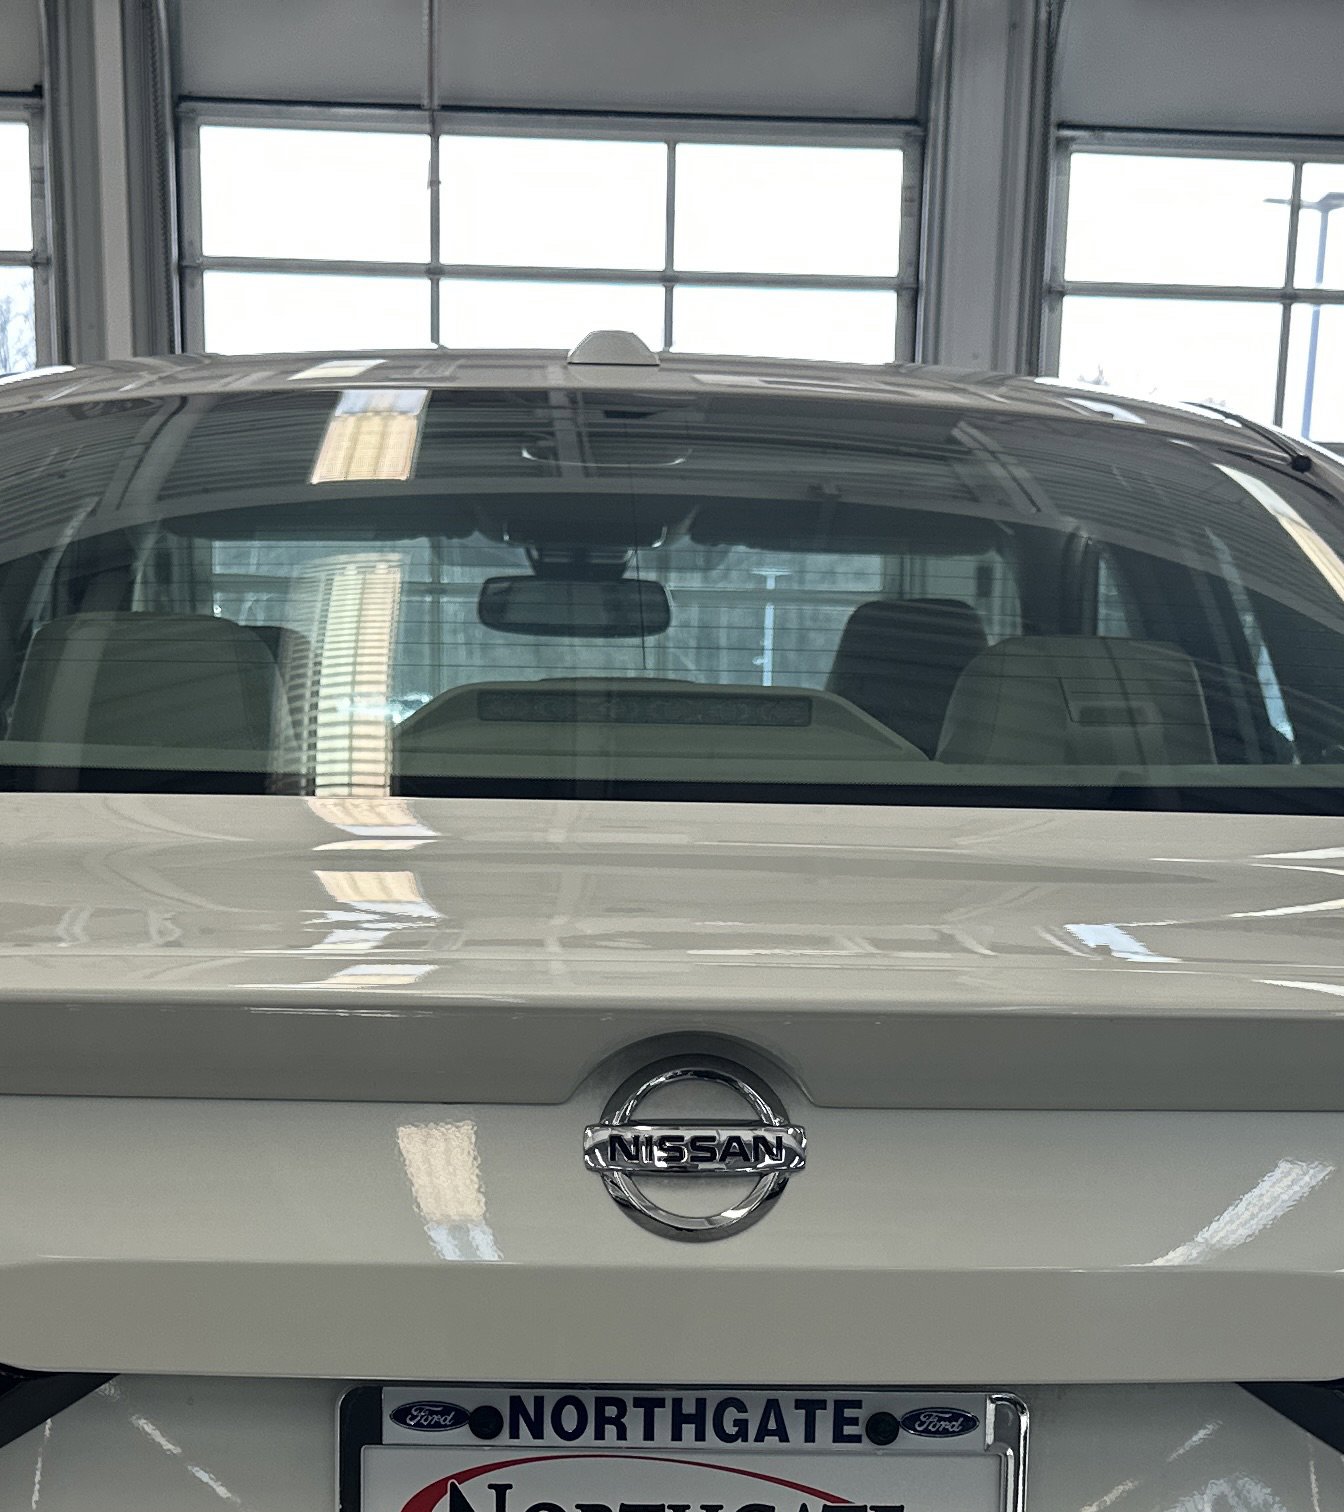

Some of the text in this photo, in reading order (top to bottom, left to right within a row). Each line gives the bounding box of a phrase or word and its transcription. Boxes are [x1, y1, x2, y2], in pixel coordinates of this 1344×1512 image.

[609, 1134, 784, 1162] NISSAN
[406, 1405, 456, 1425] Ford
[508, 1395, 863, 1444] NORTHGATE
[914, 1412, 964, 1432] Ford
